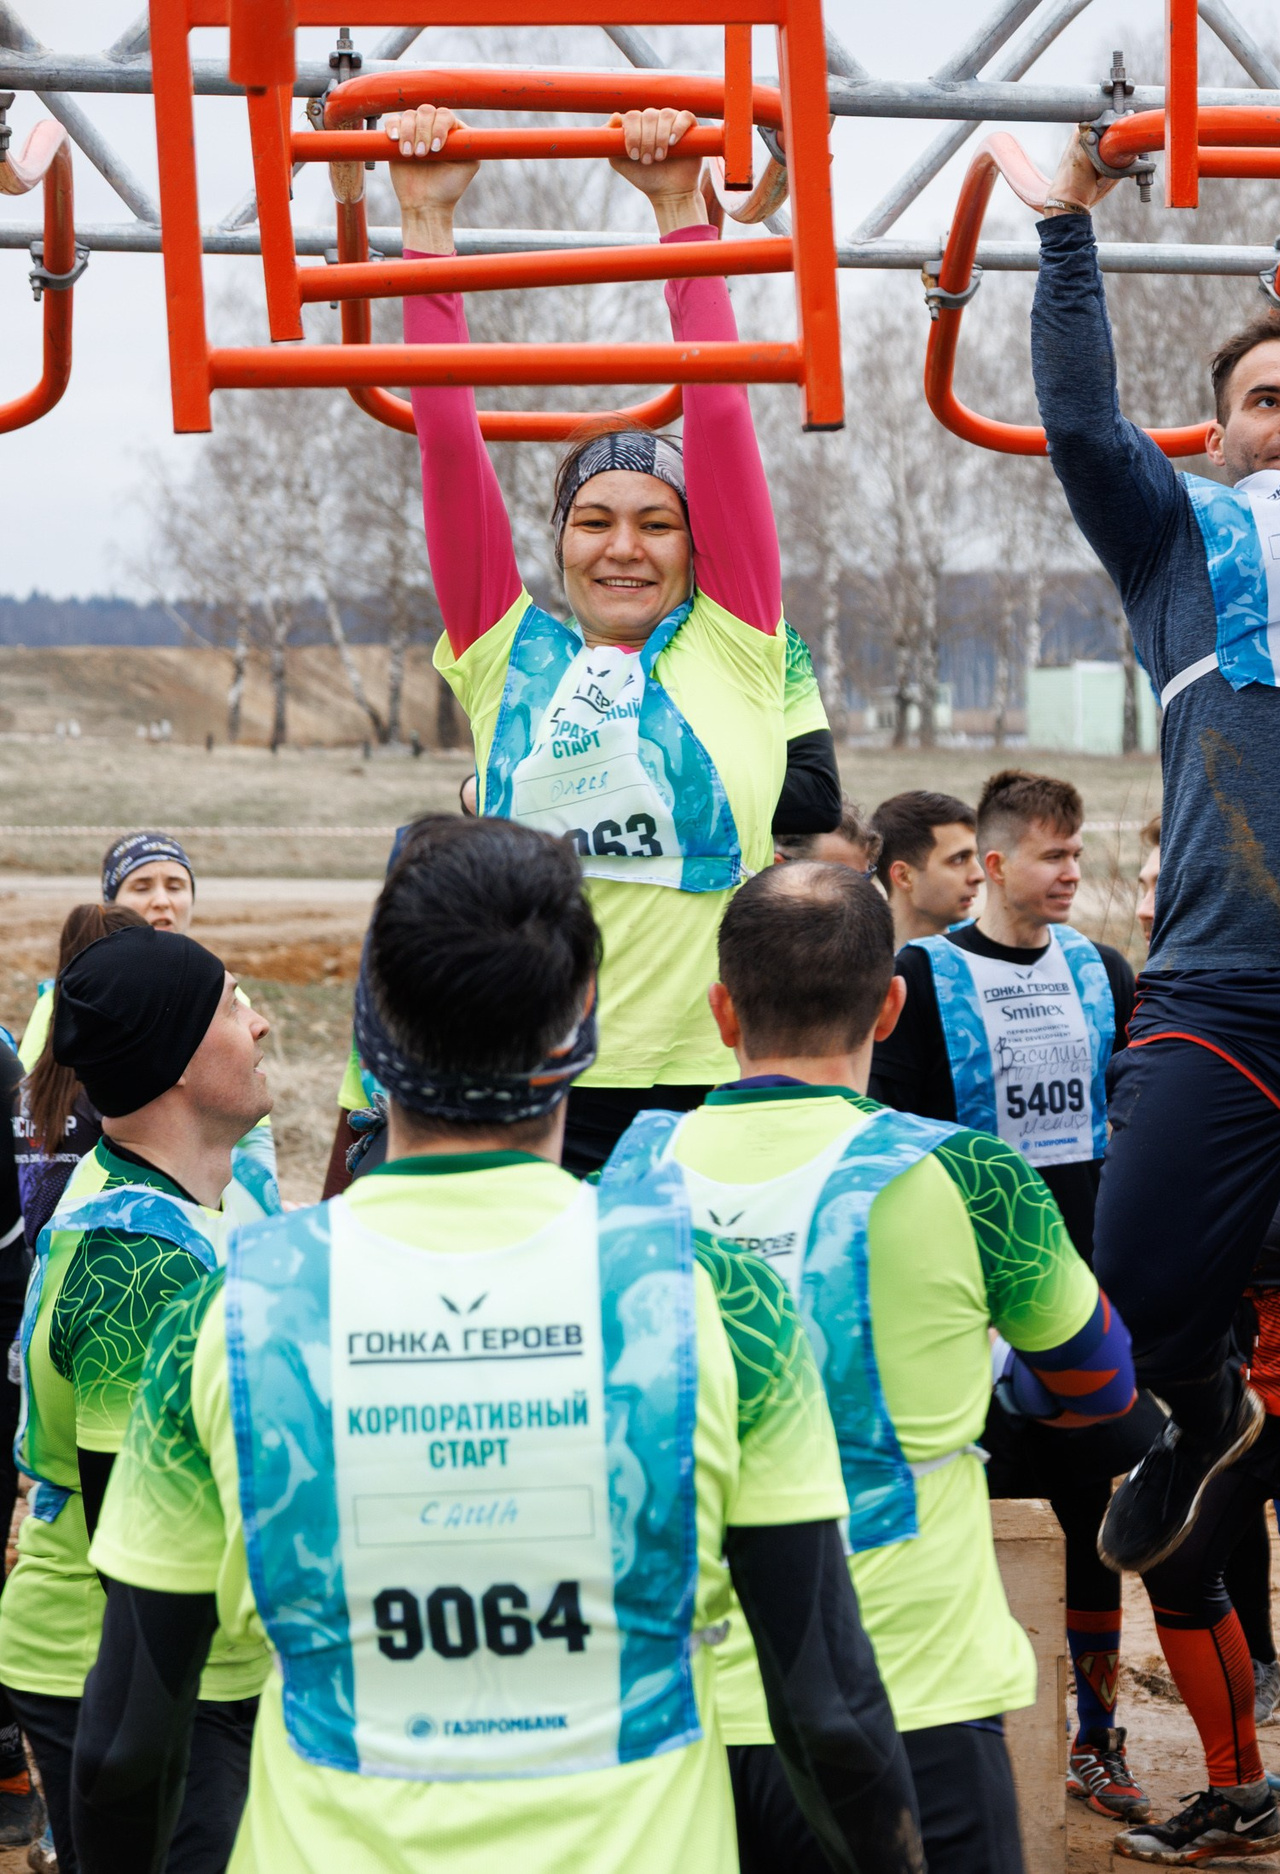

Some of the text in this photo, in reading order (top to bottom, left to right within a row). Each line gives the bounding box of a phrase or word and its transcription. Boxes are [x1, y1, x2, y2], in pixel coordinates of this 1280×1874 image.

[552, 729, 601, 760] СТАРТ
[983, 982, 1070, 1000] ГОНКА ГЕРОЕВ
[1001, 1002, 1065, 1022] Sminex
[1006, 1078, 1085, 1119] 5409
[348, 1324, 583, 1355] ГОНКА ГЕРОЕВ
[348, 1390, 589, 1435] КОРПОРАТИВНЫЙ
[429, 1438, 509, 1470] СТАРТ
[373, 1580, 591, 1661] 9064
[443, 1715, 568, 1736] ГАЗПРОМБАНК
